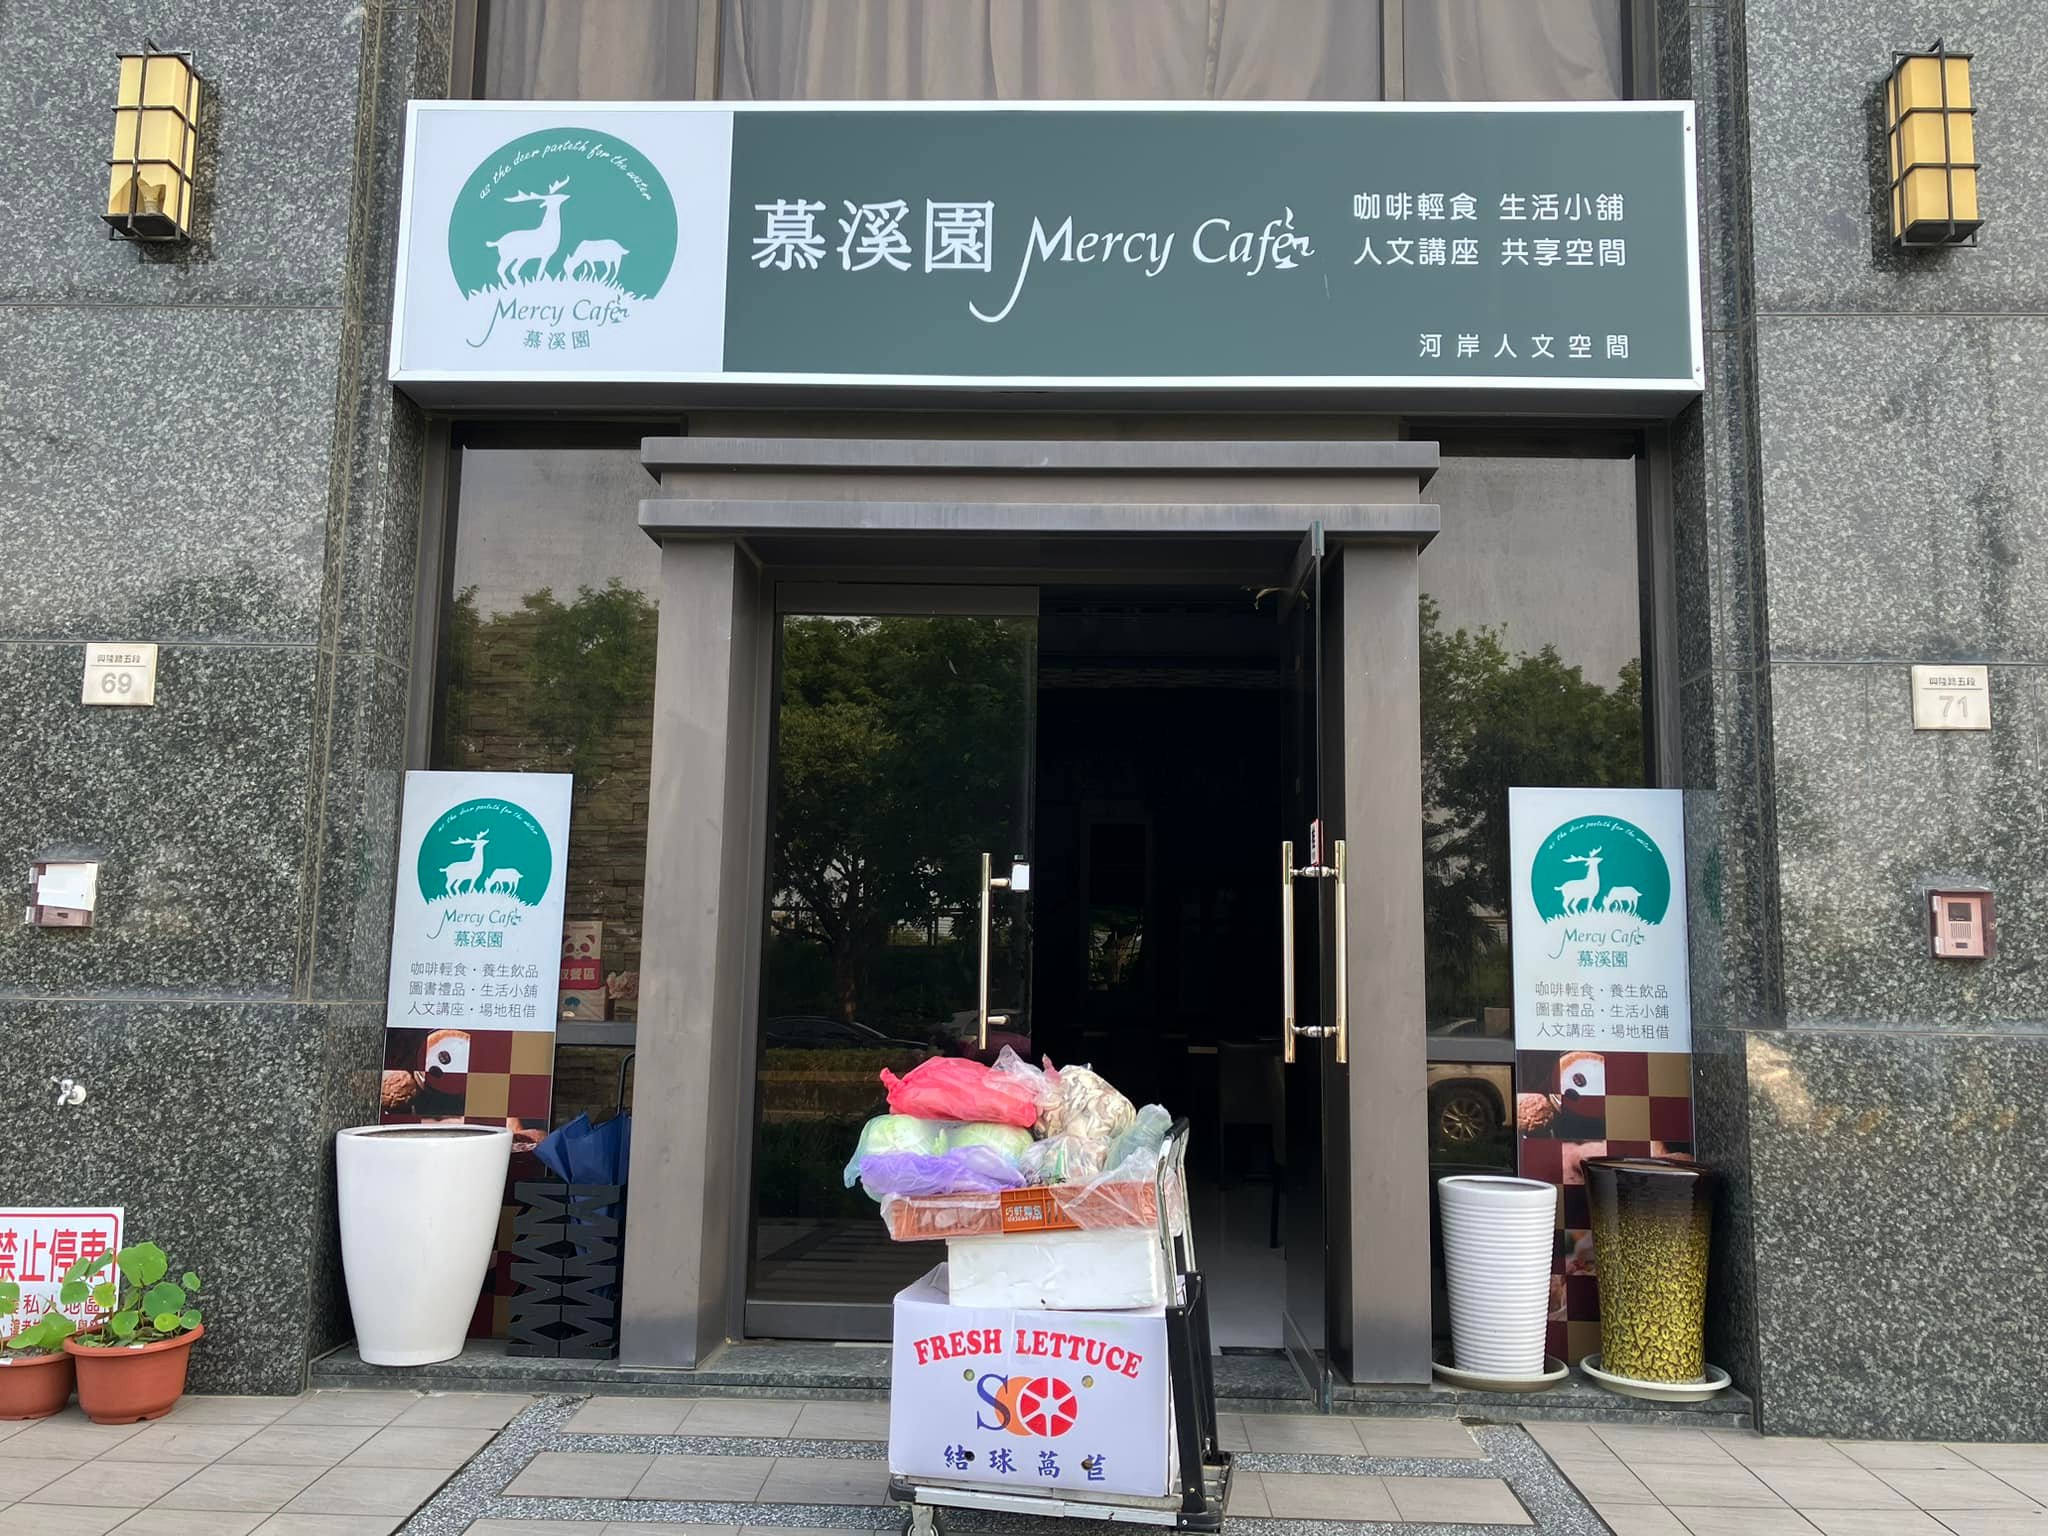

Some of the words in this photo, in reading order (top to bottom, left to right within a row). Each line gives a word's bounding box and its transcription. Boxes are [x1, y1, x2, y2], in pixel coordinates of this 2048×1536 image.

[479, 183, 491, 200] as
[493, 165, 512, 184] the
[514, 150, 541, 166] deer
[587, 144, 611, 160] for
[610, 155, 629, 171] the
[627, 170, 652, 201] water
[1353, 192, 1478, 222] 咖啡輕食
[751, 197, 995, 273] 慕溪園
[1353, 236, 1480, 266] 人文講座
[1501, 237, 1626, 267] 共享空間
[969, 216, 1174, 323] Mercy
[466, 297, 564, 348] Mercy
[523, 329, 591, 350] 慕溪園
[1418, 332, 1630, 359] 河岸人文空間
[101, 672, 132, 694] 69
[1938, 695, 1969, 719] 71
[426, 909, 484, 940] Mercy
[454, 931, 503, 948] 慕溪園
[1547, 927, 1607, 960] Mercy
[1577, 950, 1628, 968] 慕溪園
[913, 1329, 1002, 1365] FRESH
[1015, 1329, 1143, 1379] LETTUCE
